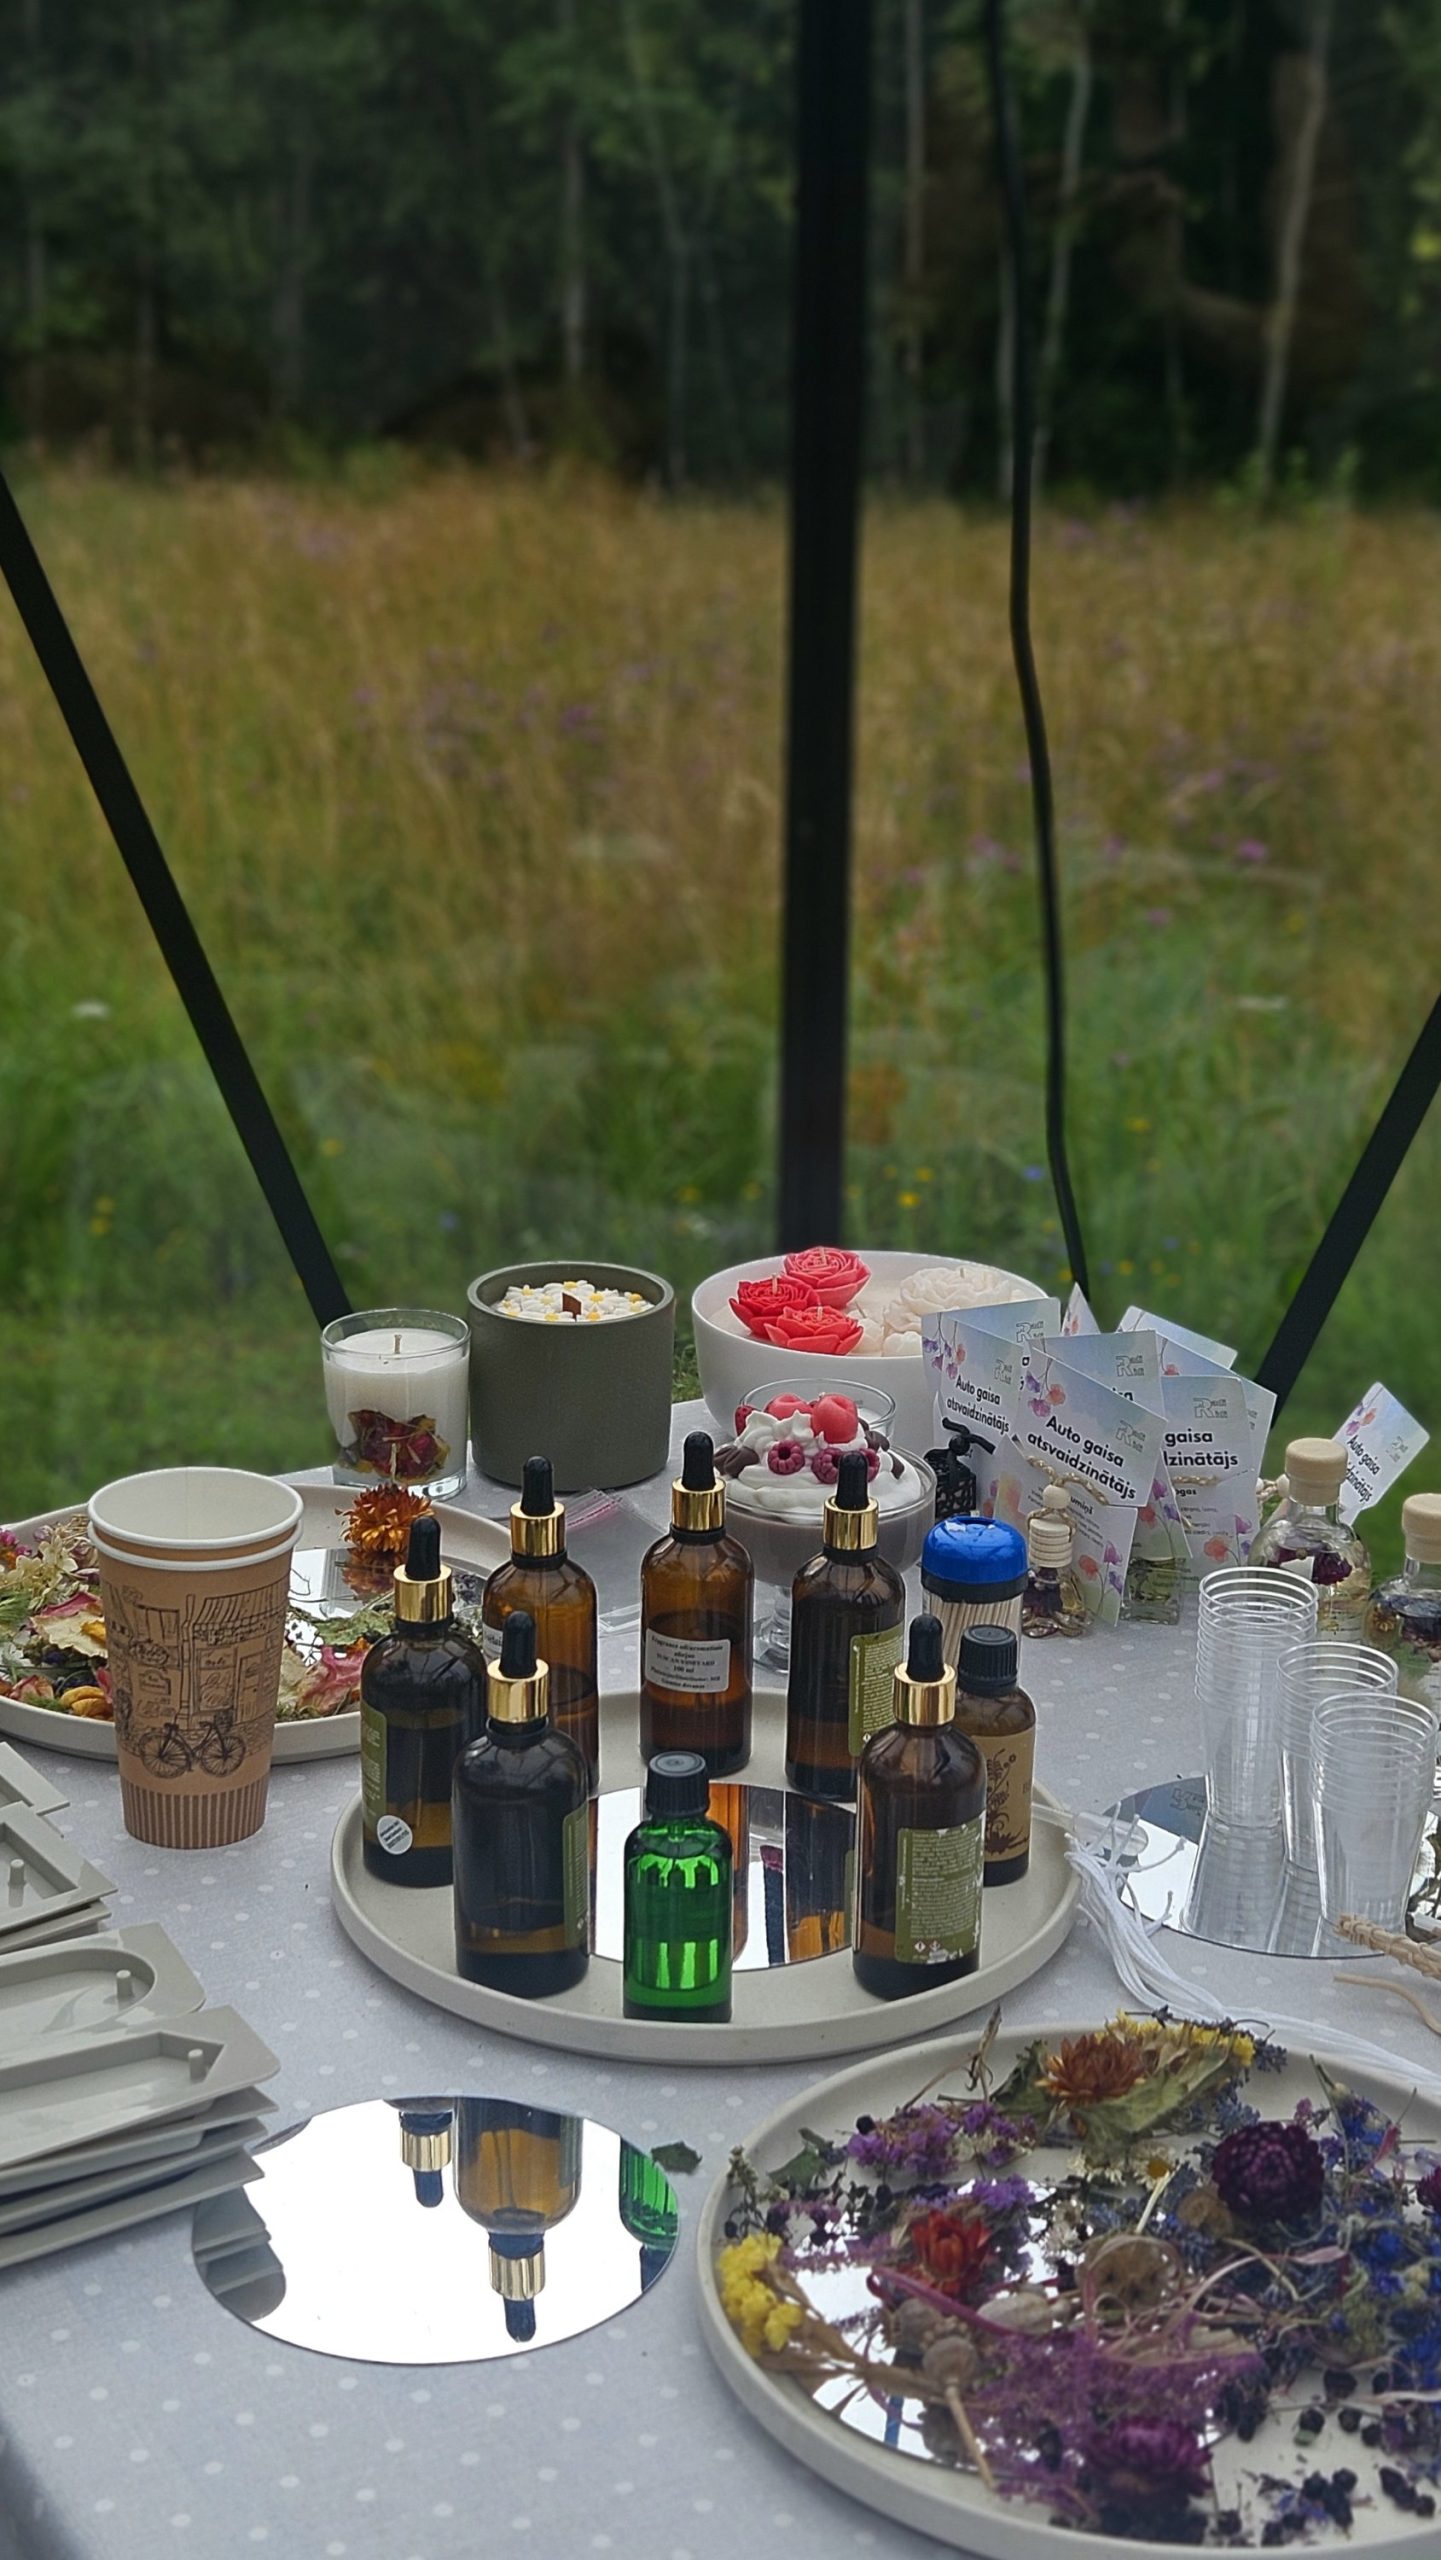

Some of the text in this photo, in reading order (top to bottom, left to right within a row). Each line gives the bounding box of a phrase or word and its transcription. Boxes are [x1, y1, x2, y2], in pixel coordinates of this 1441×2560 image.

[955, 1374, 1001, 1405] Auto gaisa
[947, 1398, 1010, 1435] atsvaidzinātājs
[1046, 1415, 1081, 1444] Auto
[1083, 1444, 1124, 1467] gaisa
[1164, 1427, 1213, 1447] gaisa
[1347, 1434, 1381, 1475] Auto gaisa
[1027, 1433, 1136, 1500] atsvaidzinātājs
